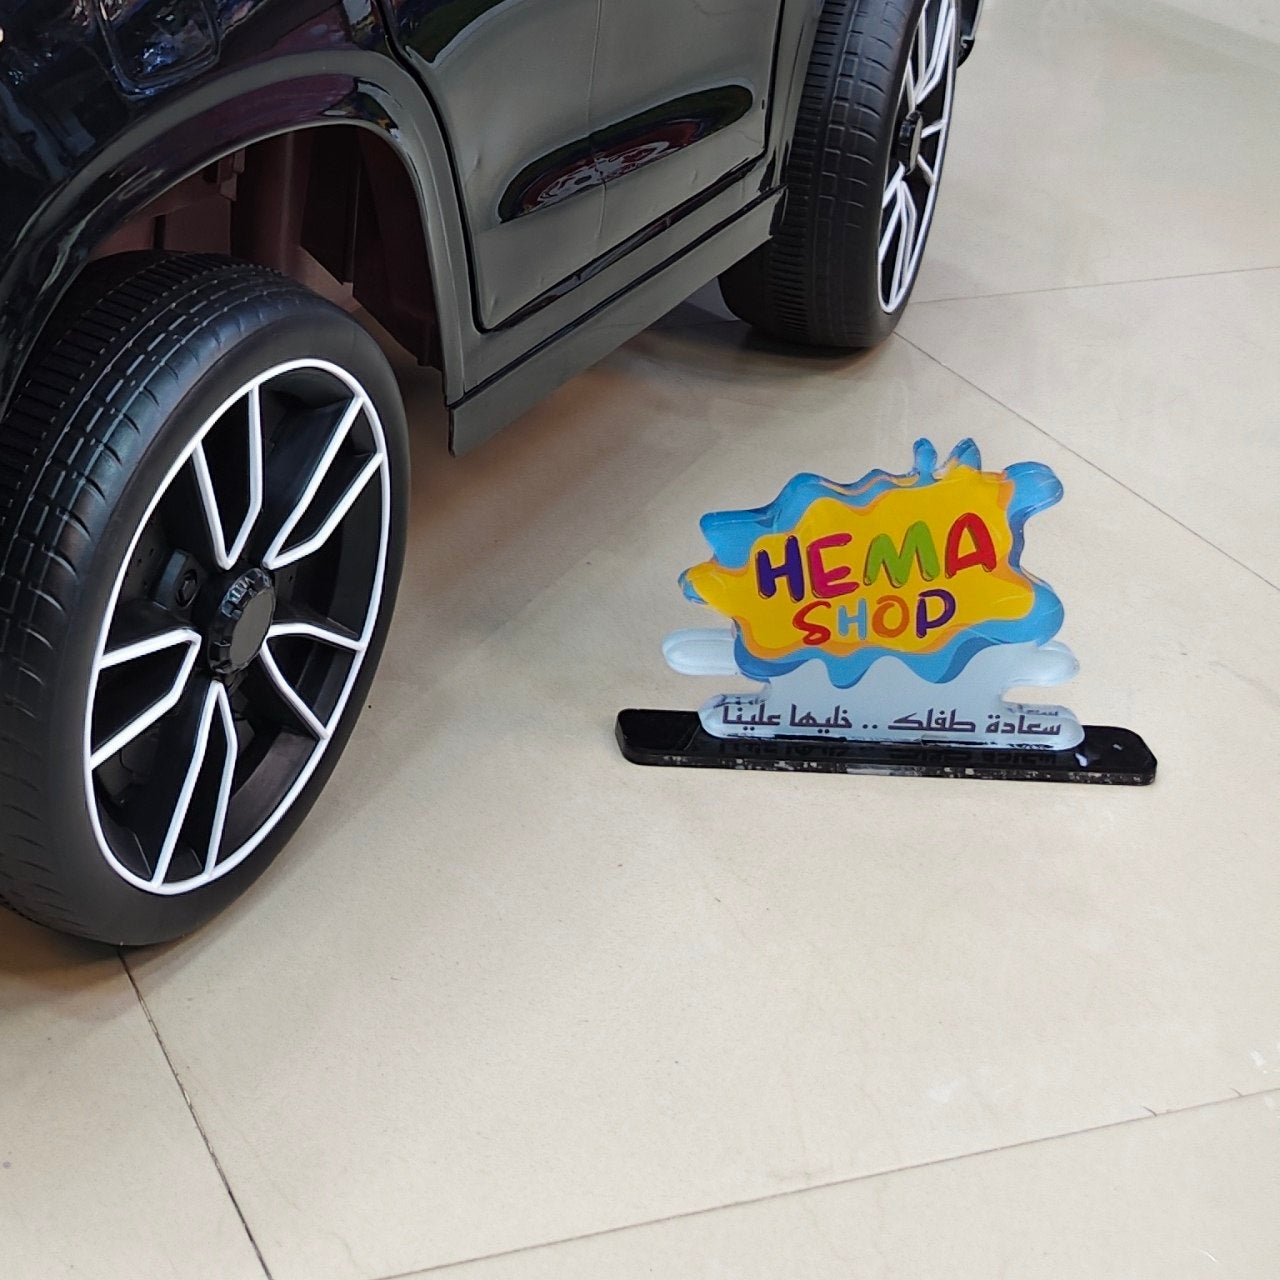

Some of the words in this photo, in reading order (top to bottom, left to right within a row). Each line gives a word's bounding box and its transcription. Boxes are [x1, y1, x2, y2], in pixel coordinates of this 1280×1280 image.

[754, 511, 998, 603] HEMA
[791, 587, 958, 646] SHOP
[721, 701, 782, 732] علينا
[788, 703, 854, 735] خليها
[887, 706, 976, 734] طفلك
[984, 711, 1062, 737] سعادة
